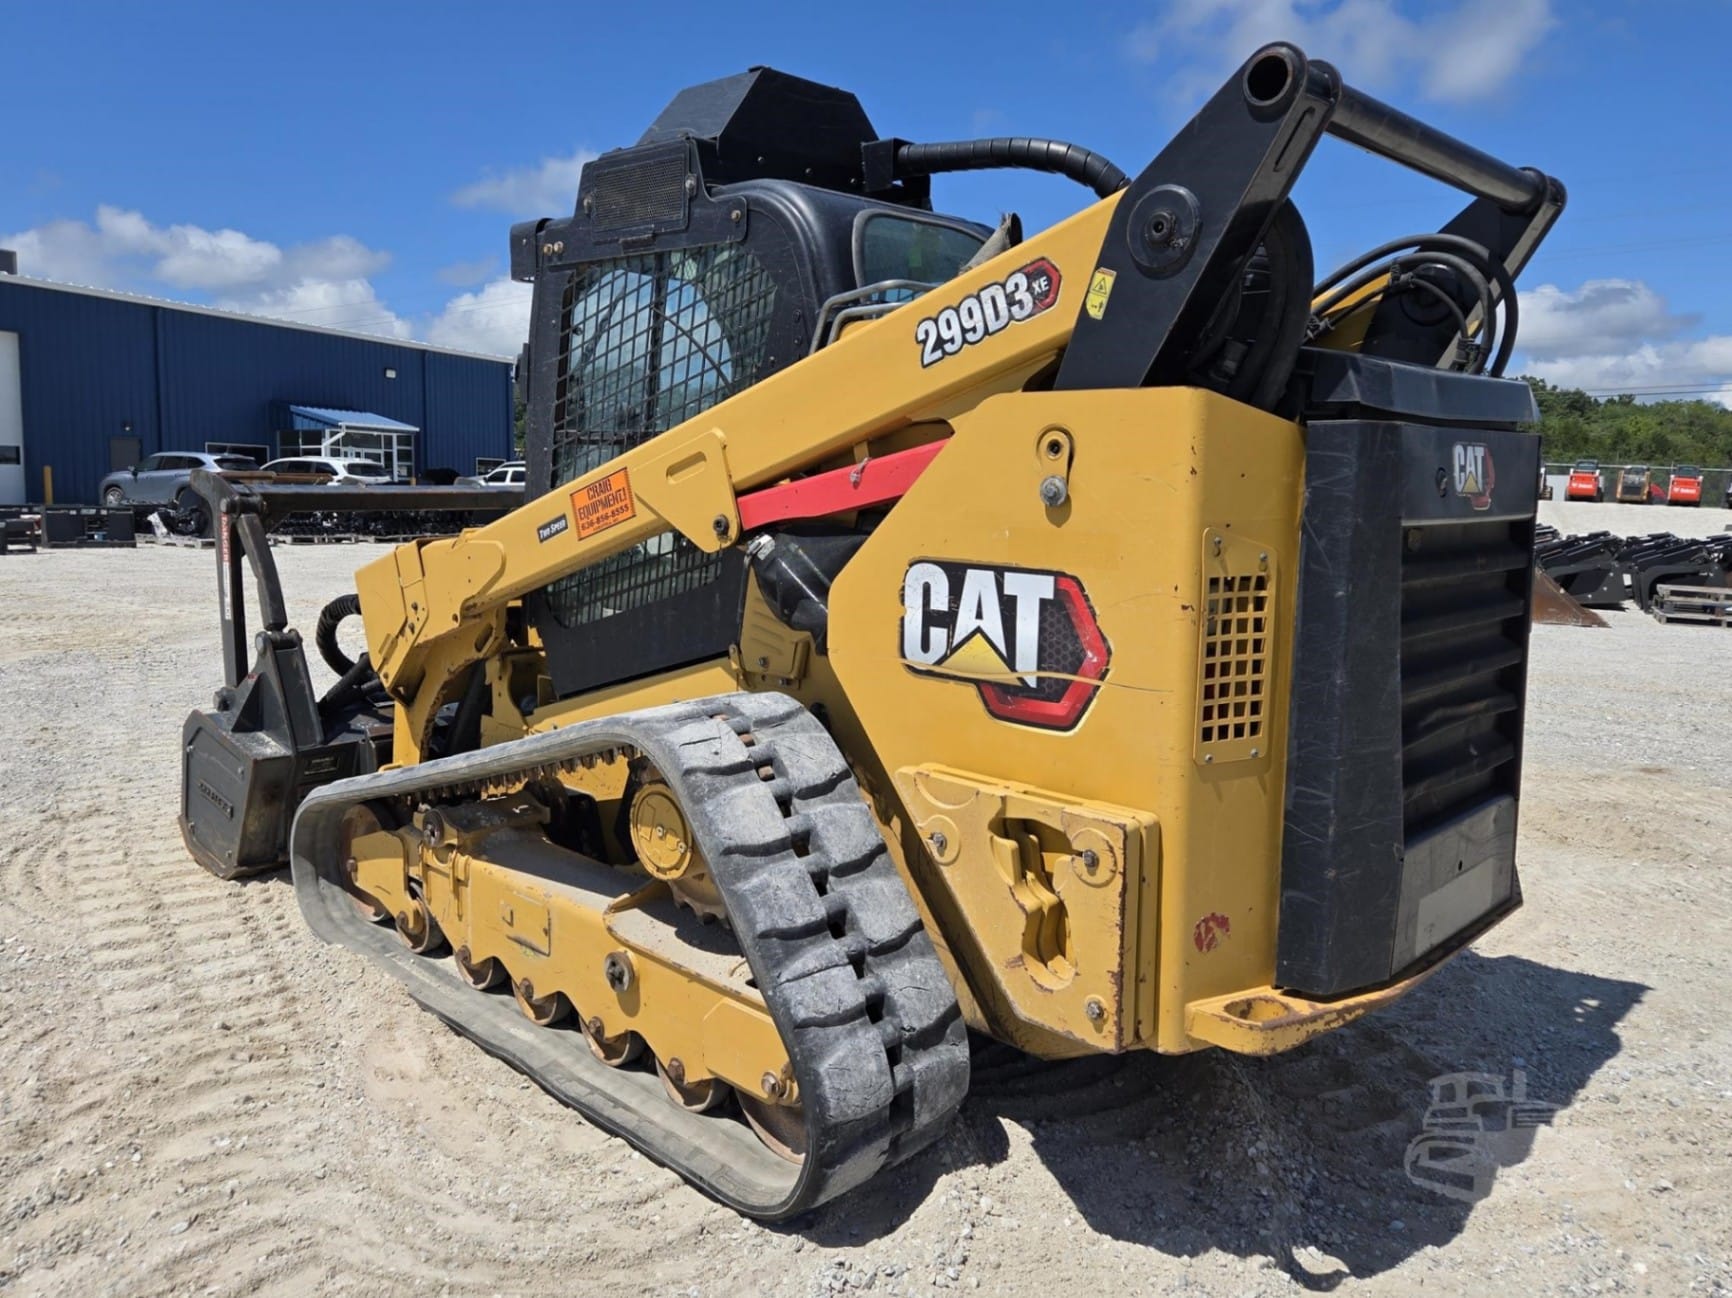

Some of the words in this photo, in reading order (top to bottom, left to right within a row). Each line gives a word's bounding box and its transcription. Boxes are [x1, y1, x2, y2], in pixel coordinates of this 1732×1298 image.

[916, 271, 1034, 367] 299D3
[1032, 276, 1050, 296] XE
[586, 478, 612, 501] CRAIG
[1454, 444, 1485, 493] CAT
[903, 562, 1055, 689] CAT
